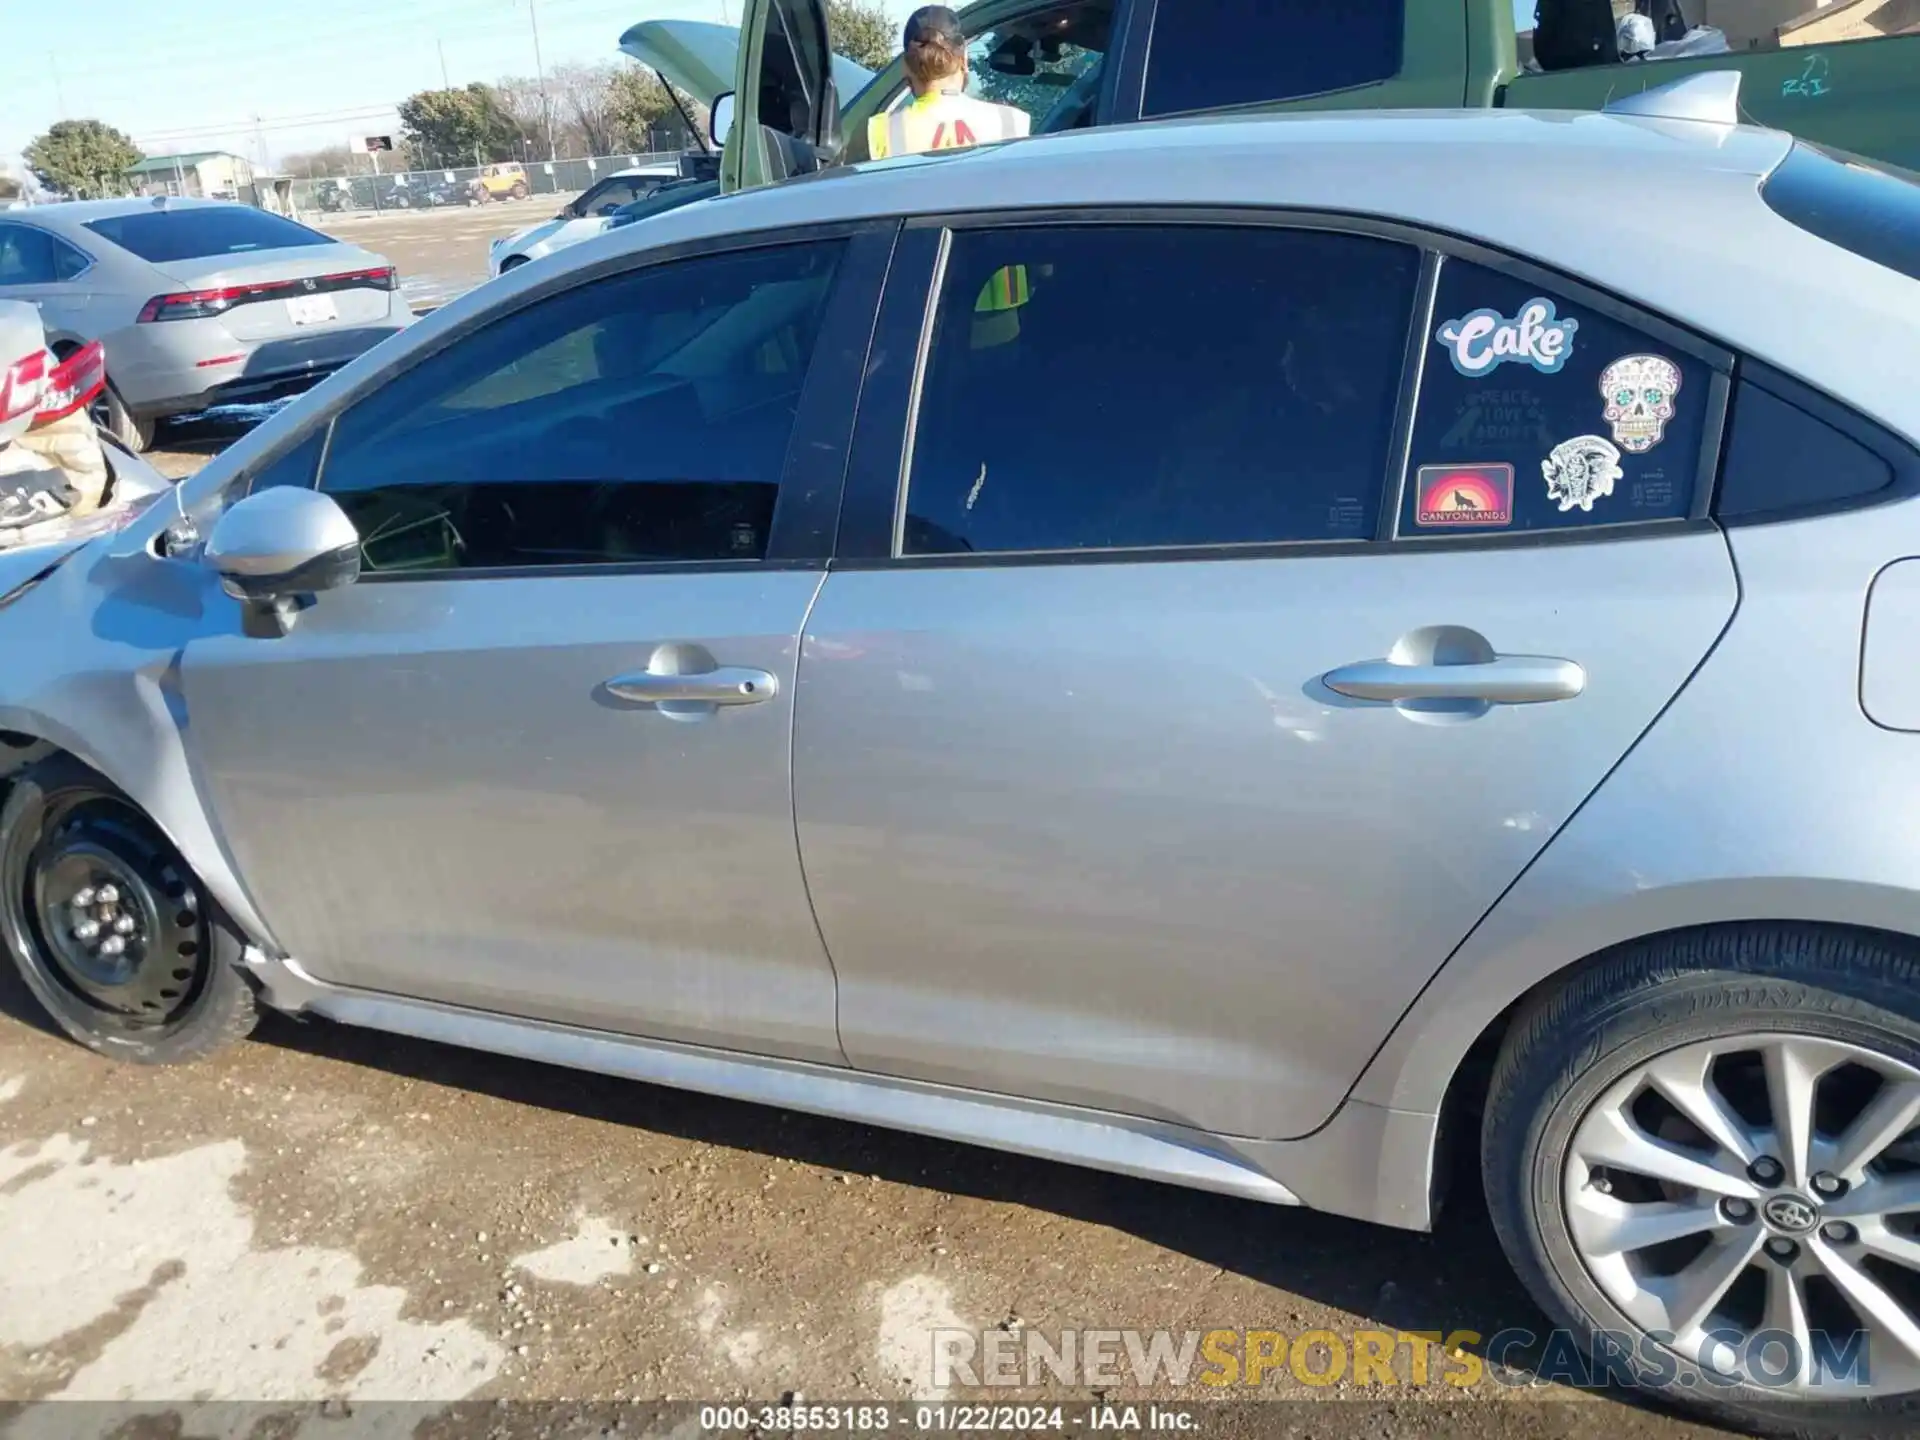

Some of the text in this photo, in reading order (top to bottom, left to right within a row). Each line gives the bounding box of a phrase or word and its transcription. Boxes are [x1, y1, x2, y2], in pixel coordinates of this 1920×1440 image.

[1443, 304, 1564, 369] Cake
[1481, 389, 1531, 404] PEACE
[1420, 511, 1506, 521] CANYONLANDS
